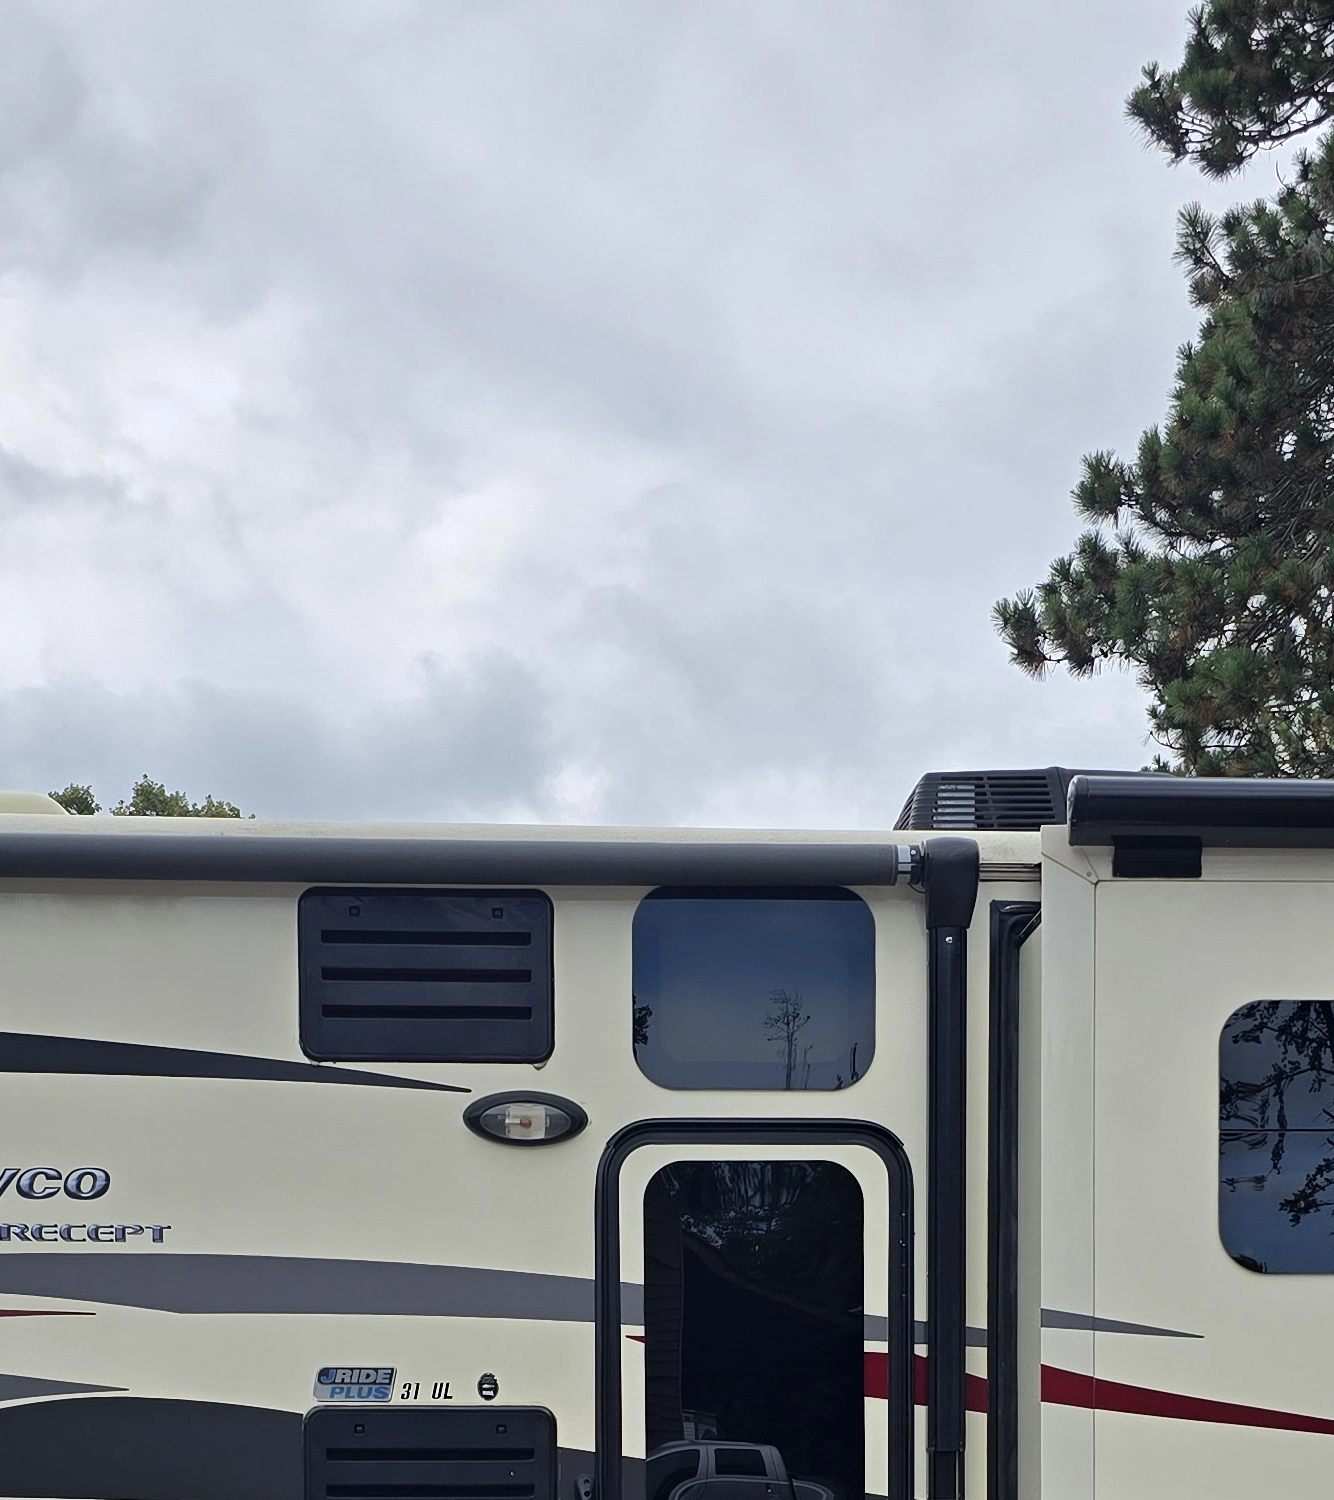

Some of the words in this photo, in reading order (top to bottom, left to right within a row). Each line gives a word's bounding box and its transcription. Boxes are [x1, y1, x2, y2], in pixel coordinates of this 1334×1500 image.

[320, 1369, 392, 1384] JRIDE
[329, 1386, 390, 1399] PLUS
[400, 1382, 421, 1400] 31
[432, 1382, 453, 1400] UL
